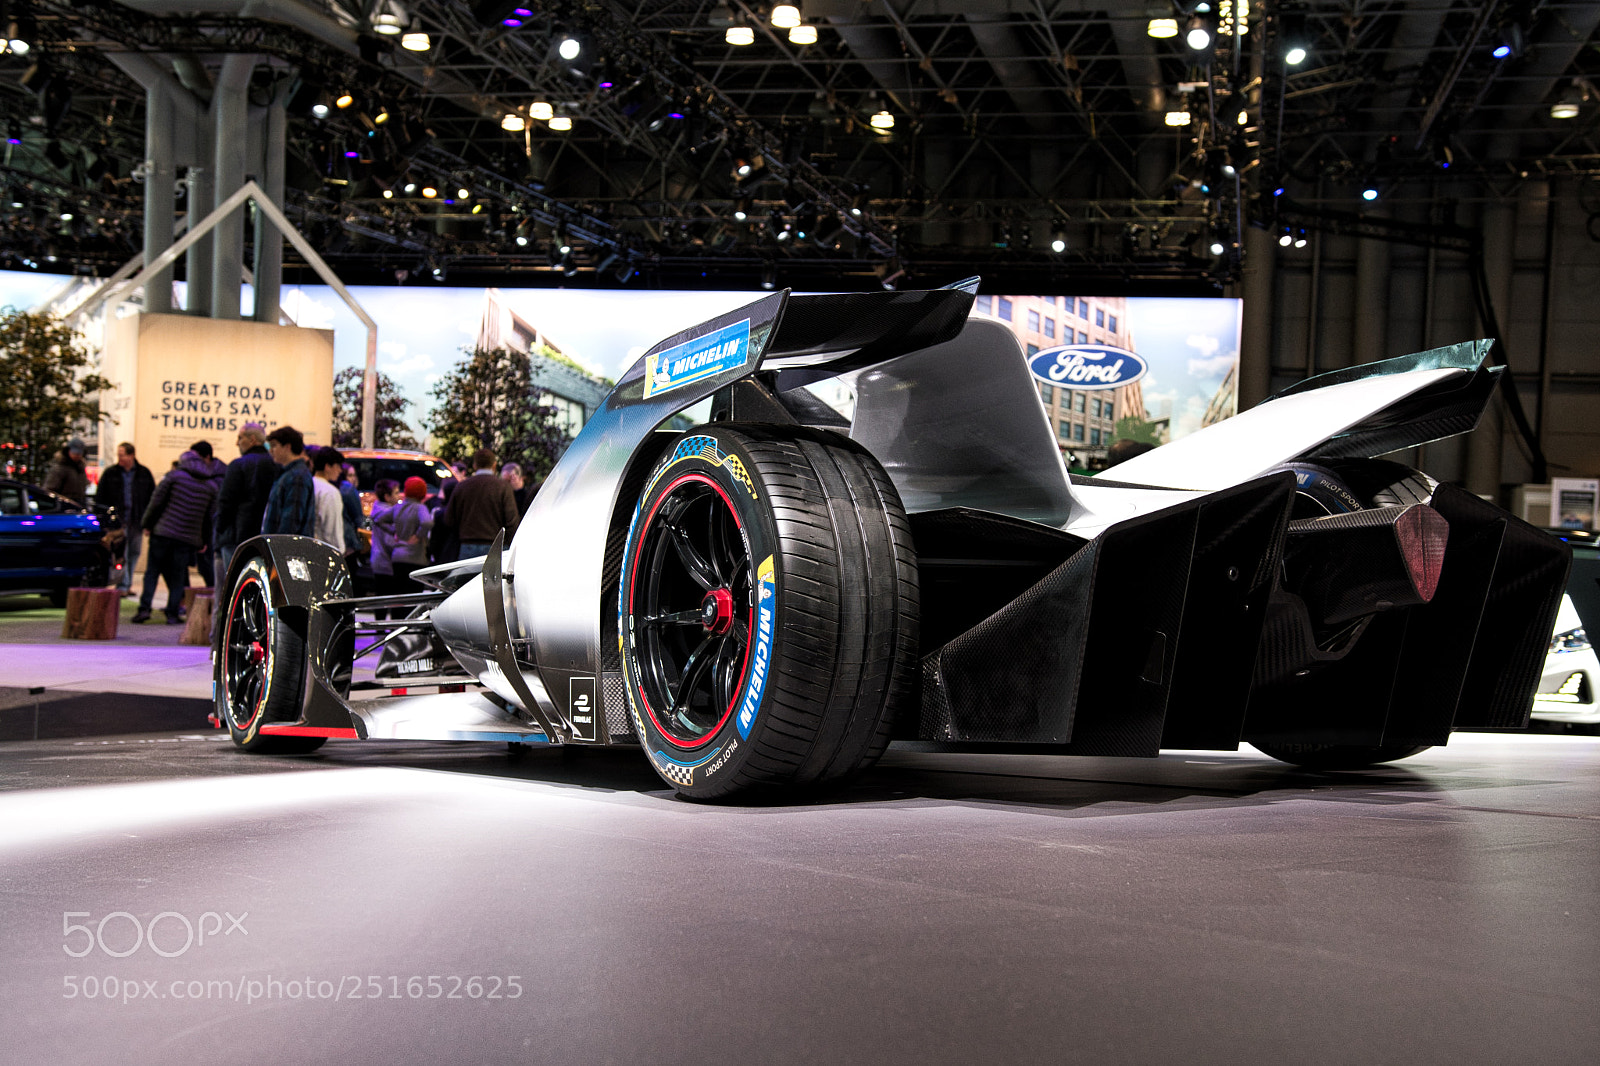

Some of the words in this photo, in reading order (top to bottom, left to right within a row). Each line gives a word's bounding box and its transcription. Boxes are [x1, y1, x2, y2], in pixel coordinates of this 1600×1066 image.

[671, 338, 740, 377] MICHELIN
[1048, 349, 1124, 383] Ford
[162, 380, 220, 397] GREAT
[227, 385, 276, 401] ROAD
[161, 397, 222, 415] SONG?
[229, 402, 267, 418] SAY,
[1320, 479, 1342, 493] PILOT
[740, 607, 771, 730] MICHELIN
[723, 738, 738, 764] PILOT
[705, 758, 724, 777] SPORT
